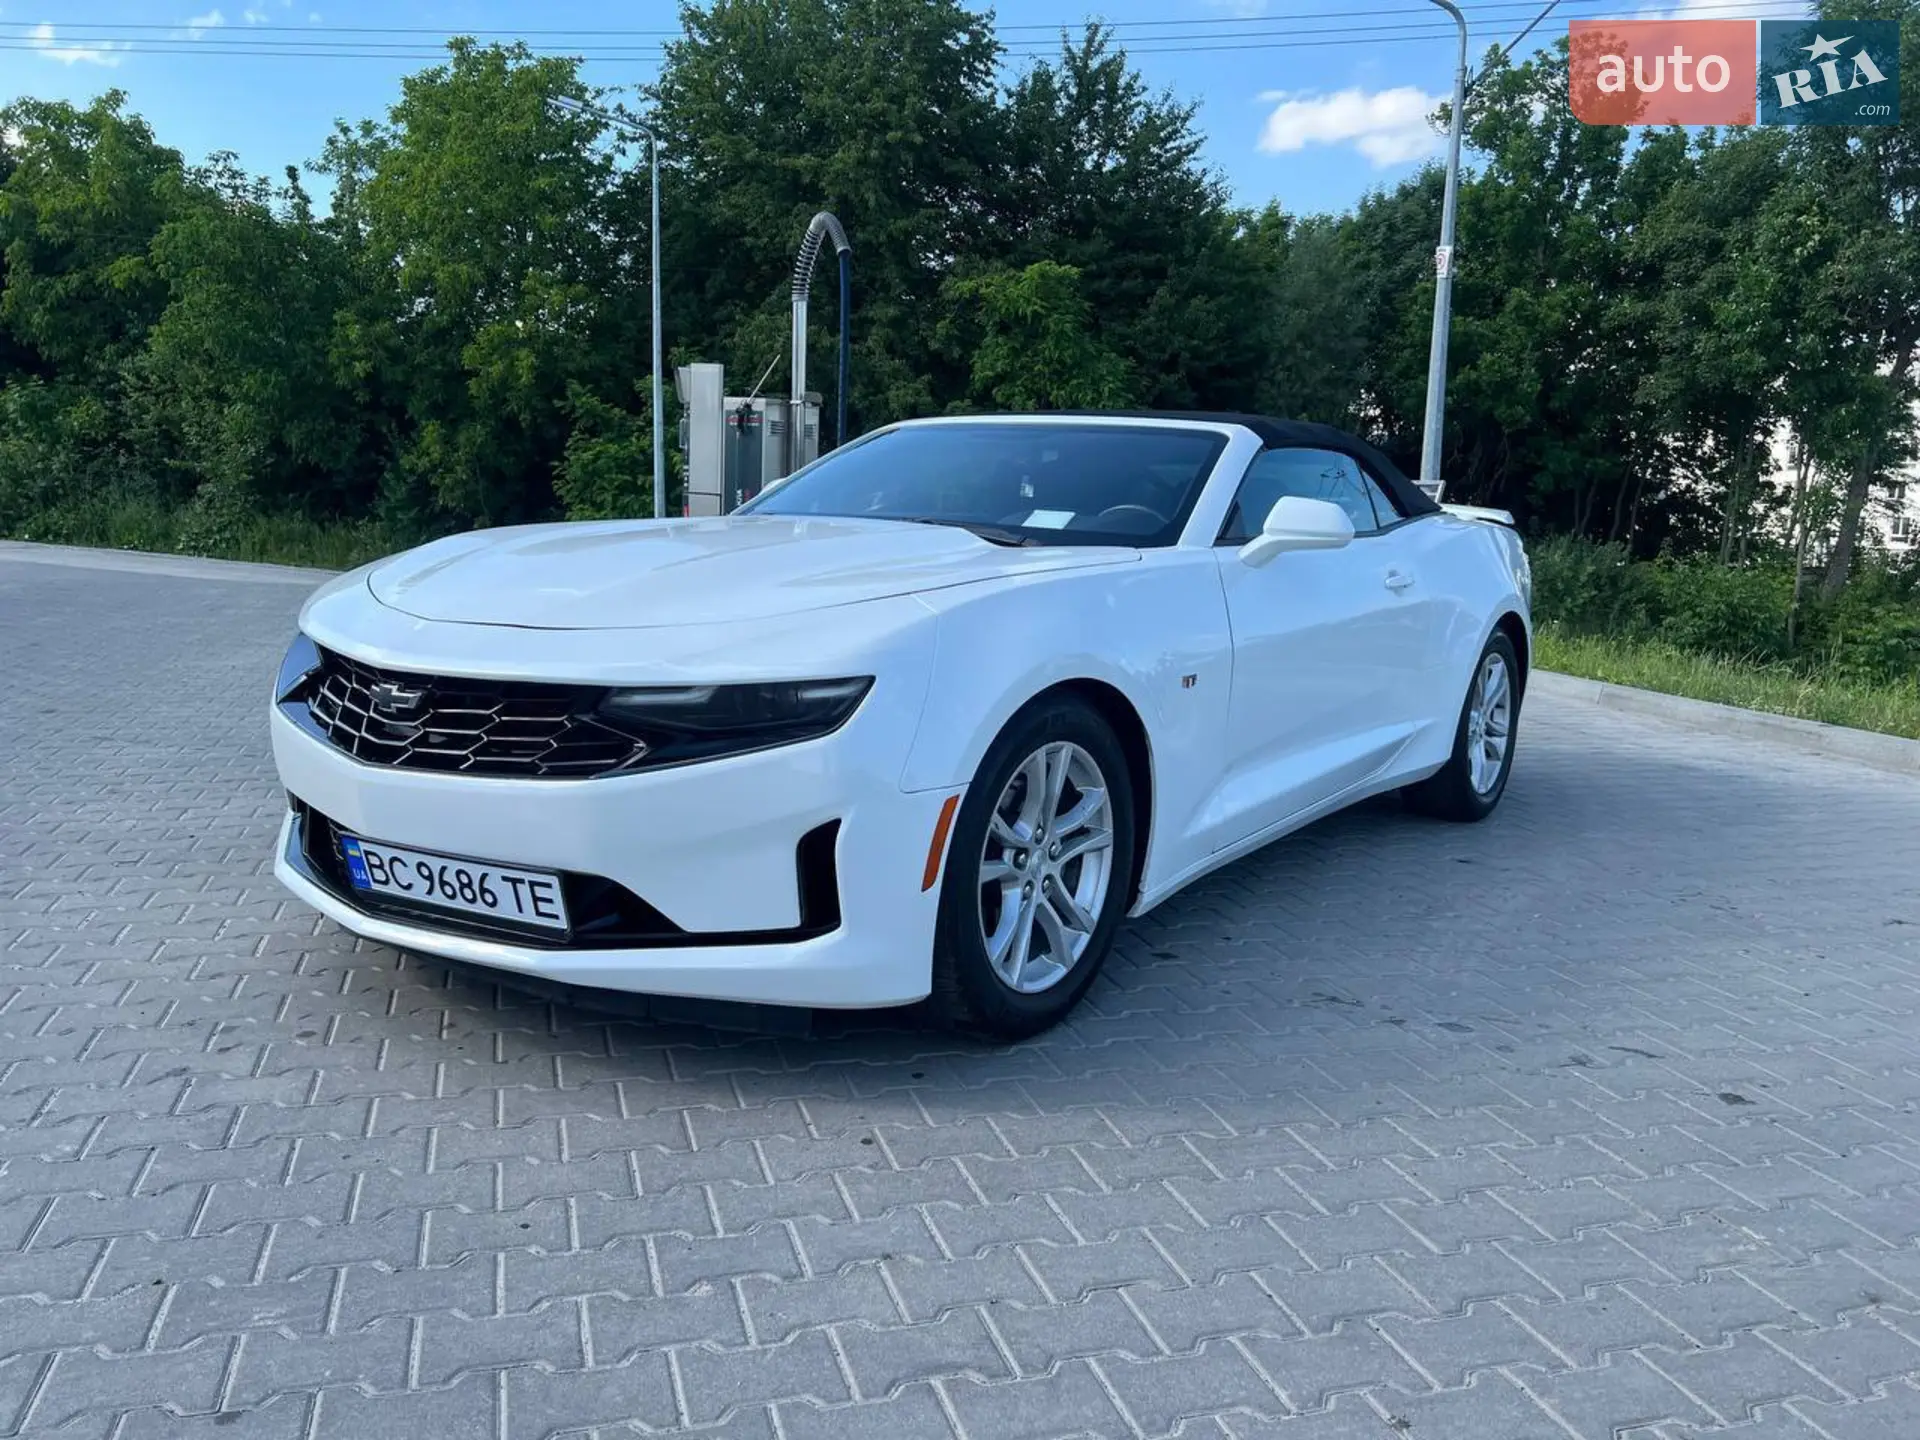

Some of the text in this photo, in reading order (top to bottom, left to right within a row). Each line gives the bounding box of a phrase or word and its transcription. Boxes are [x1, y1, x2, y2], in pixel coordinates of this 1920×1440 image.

[353, 868, 367, 882] UA
[363, 849, 560, 920] BC 9686 TE
